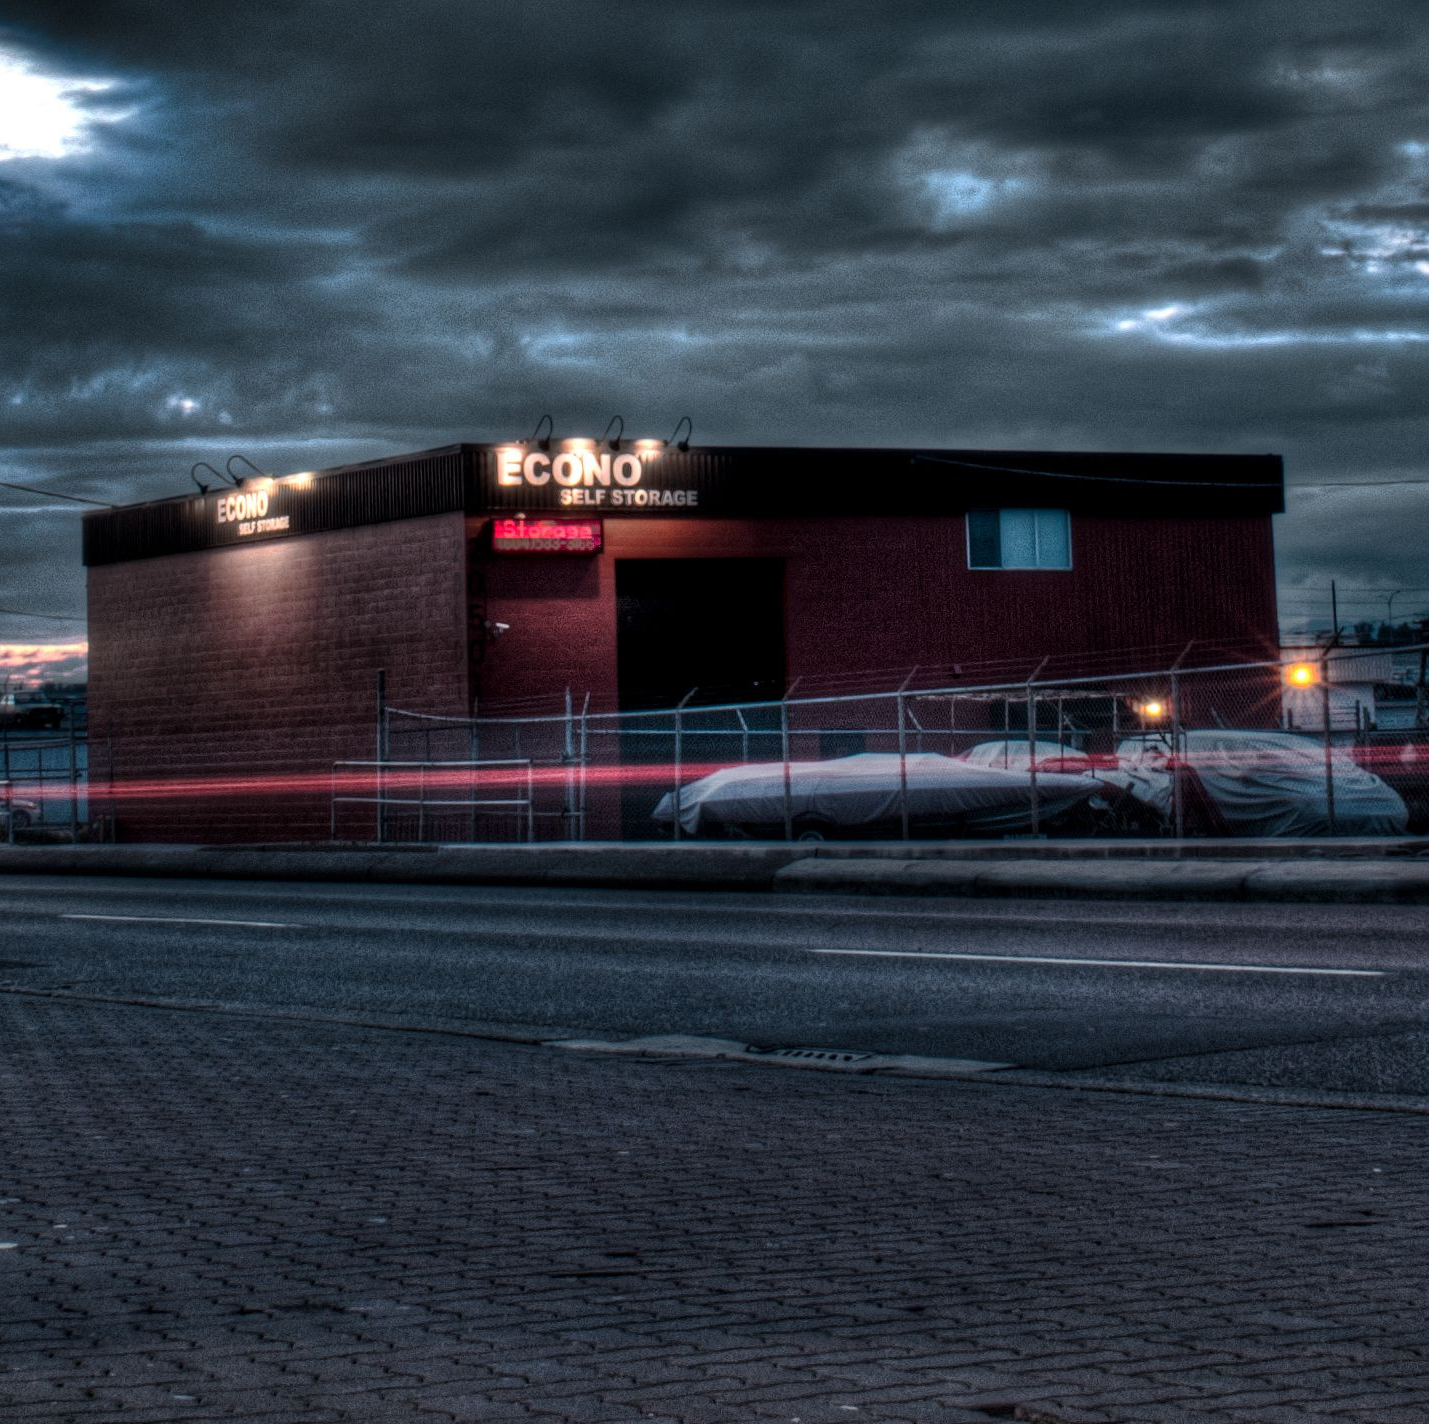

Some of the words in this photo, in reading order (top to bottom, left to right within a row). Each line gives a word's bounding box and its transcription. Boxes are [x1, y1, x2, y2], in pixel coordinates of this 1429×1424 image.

[497, 448, 642, 487] ECONO
[217, 490, 269, 523] ECONO
[561, 489, 606, 506] SELF
[611, 490, 699, 507] STORAGE
